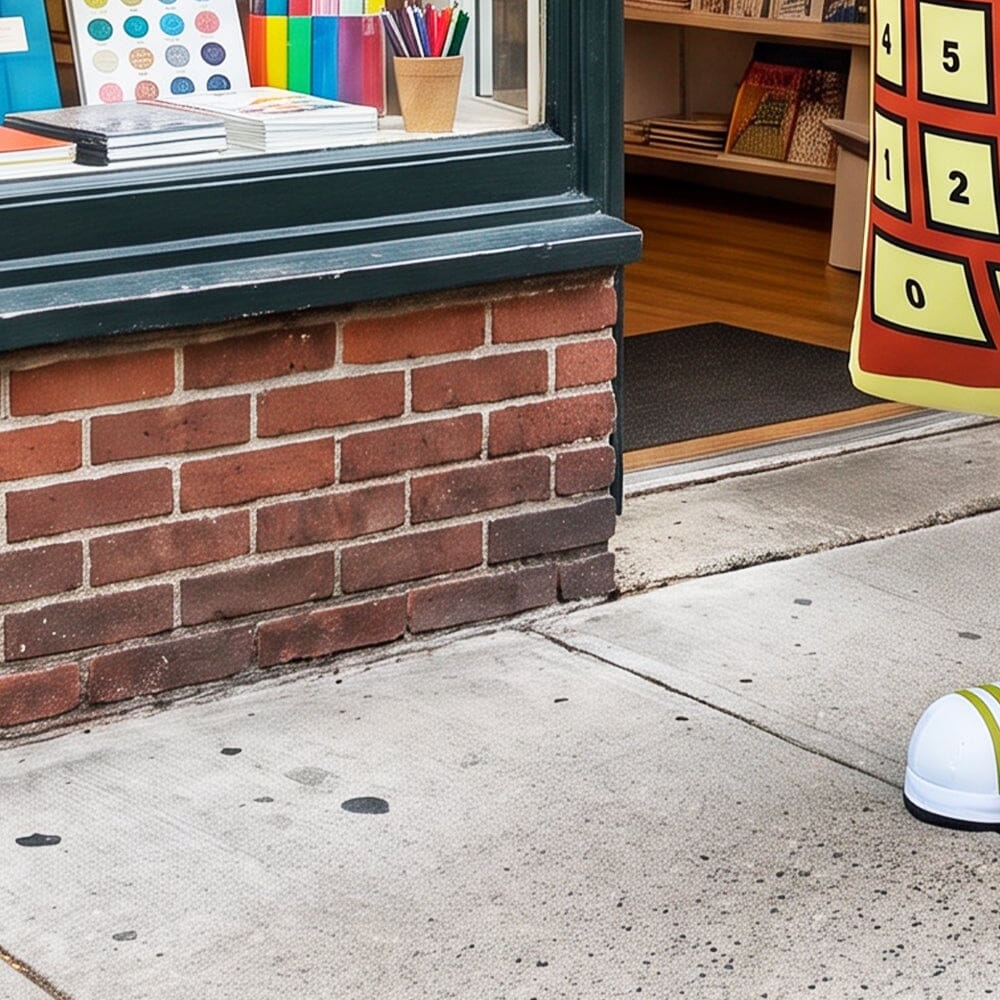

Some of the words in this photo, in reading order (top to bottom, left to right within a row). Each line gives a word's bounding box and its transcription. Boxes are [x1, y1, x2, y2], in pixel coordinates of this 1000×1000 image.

[881, 22, 892, 56] 4
[942, 39, 961, 73] 5
[884, 148, 891, 181] 1
[948, 170, 970, 206] 2
[905, 278, 926, 310] 0
